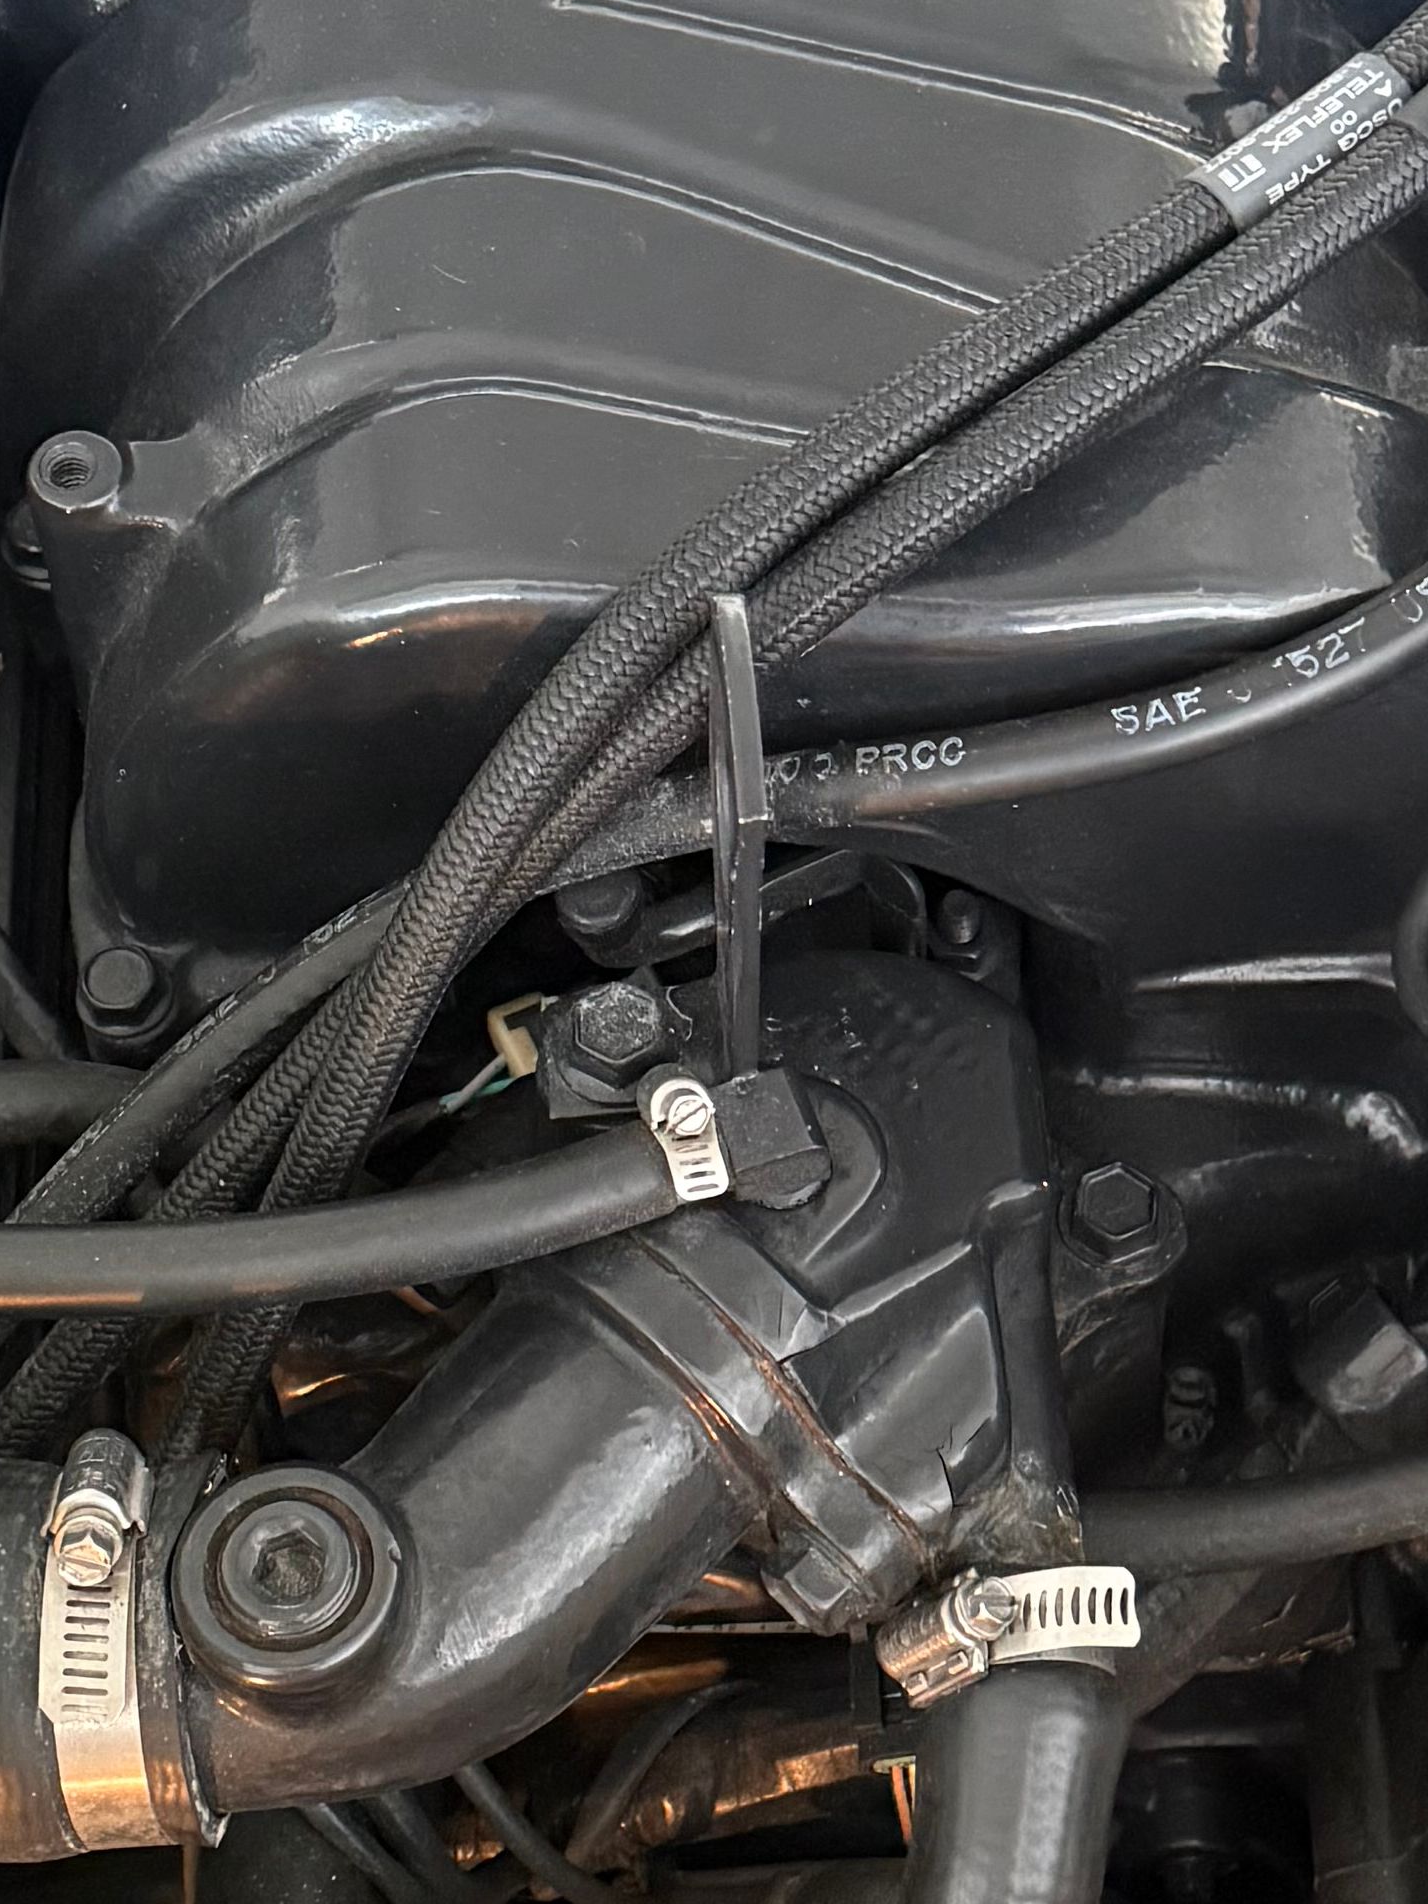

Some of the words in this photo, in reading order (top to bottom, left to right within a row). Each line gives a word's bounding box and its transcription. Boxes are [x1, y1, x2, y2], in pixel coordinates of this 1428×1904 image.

[1263, 67, 1384, 154] TELEFLEX
[1374, 78, 1393, 98] A
[1338, 98, 1403, 152] USCG
[1265, 155, 1332, 205] TYPE
[1111, 687, 1207, 736] SAE
